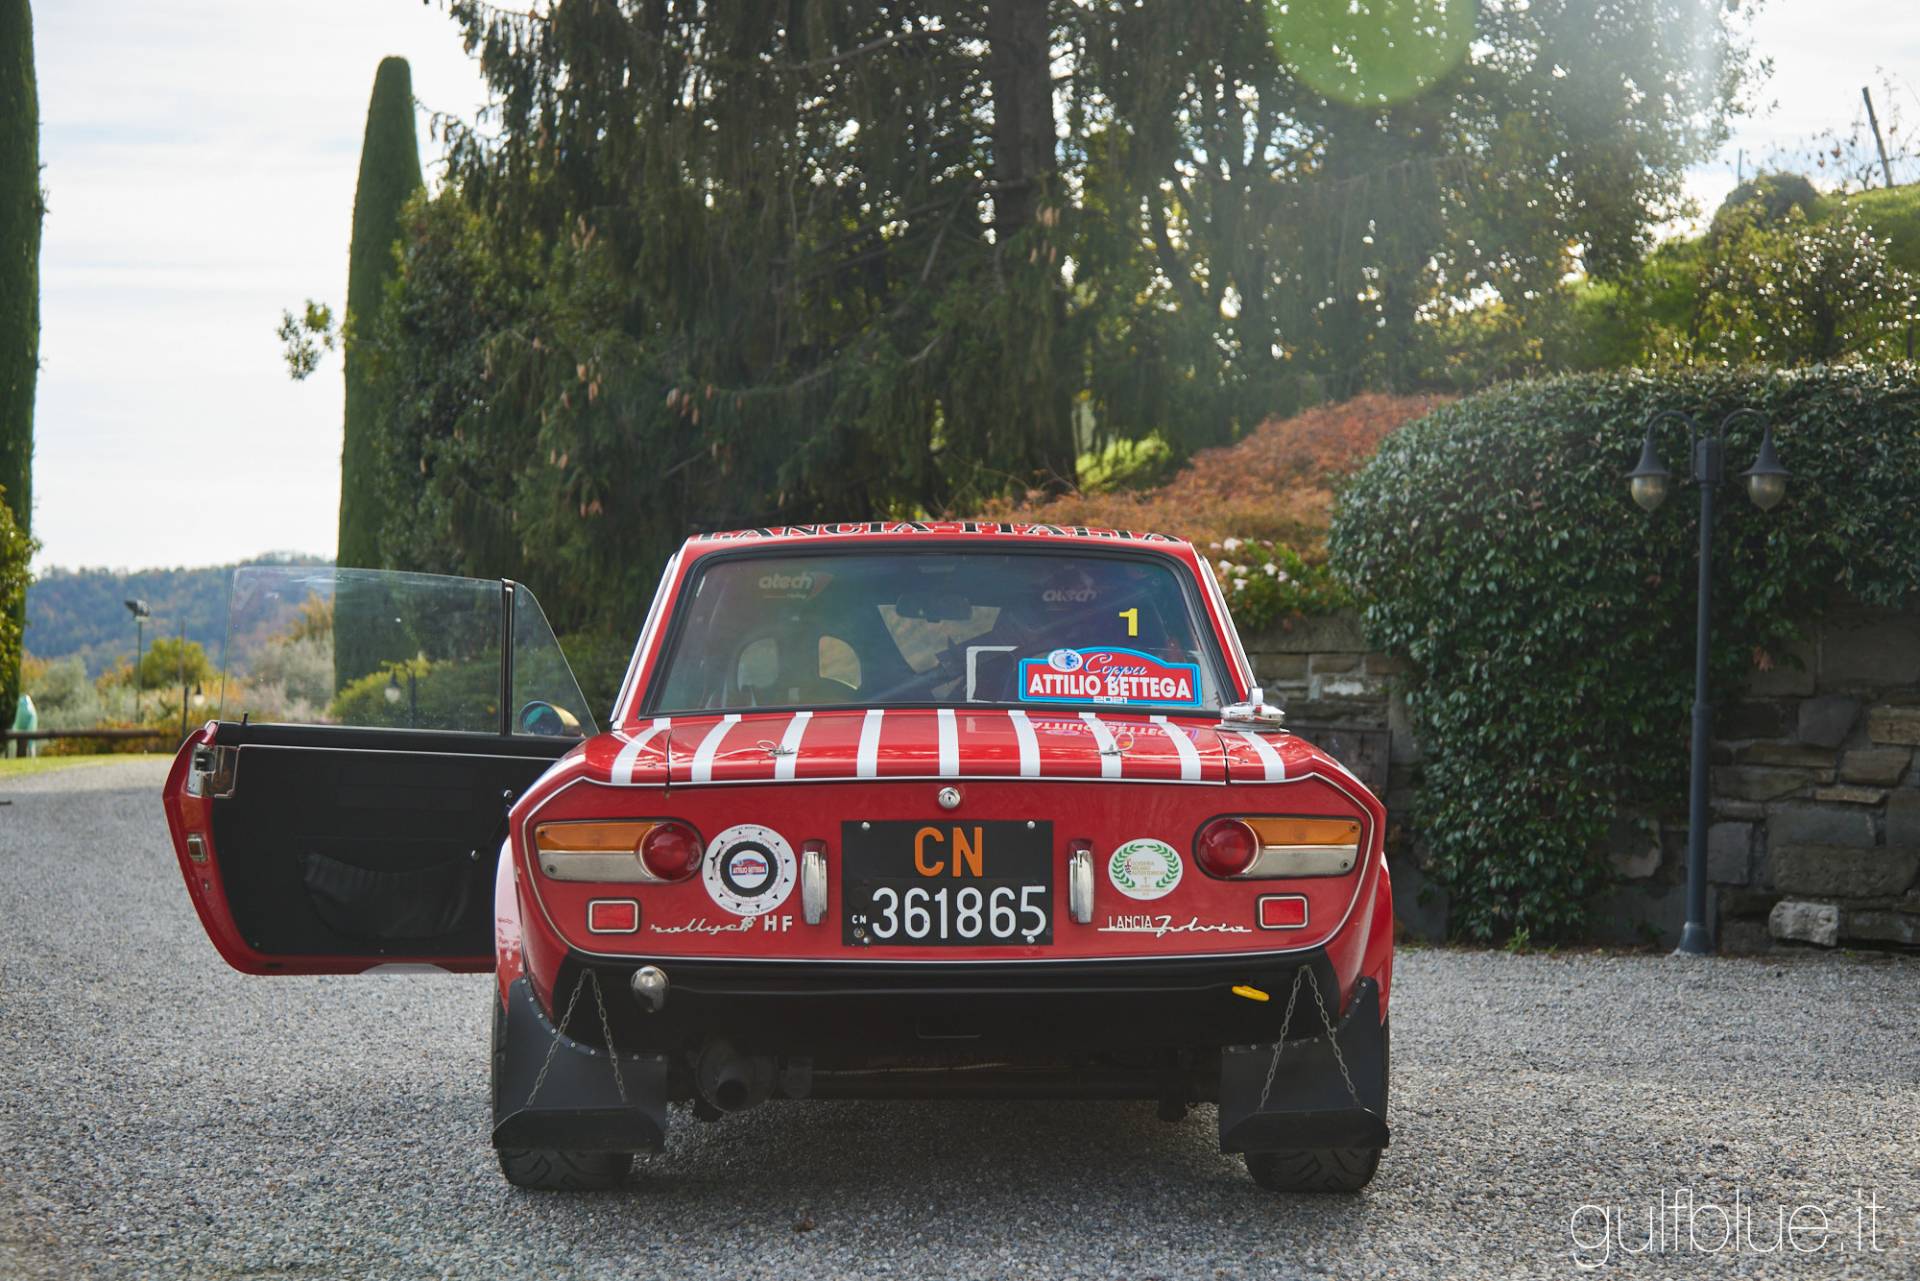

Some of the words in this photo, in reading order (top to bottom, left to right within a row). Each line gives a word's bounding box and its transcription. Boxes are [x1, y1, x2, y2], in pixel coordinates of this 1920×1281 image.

[1119, 608, 1138, 637] 1
[1084, 653, 1148, 682] Coppa
[1029, 673, 1101, 695] ATTILIO
[1107, 676, 1192, 699] BETTEGA
[1092, 695, 1128, 704] 2021
[914, 826, 983, 878] CN
[764, 915, 793, 932] HF
[851, 914, 867, 924] CN
[872, 885, 1047, 939] 361865
[1108, 915, 1153, 929] LANCIA
